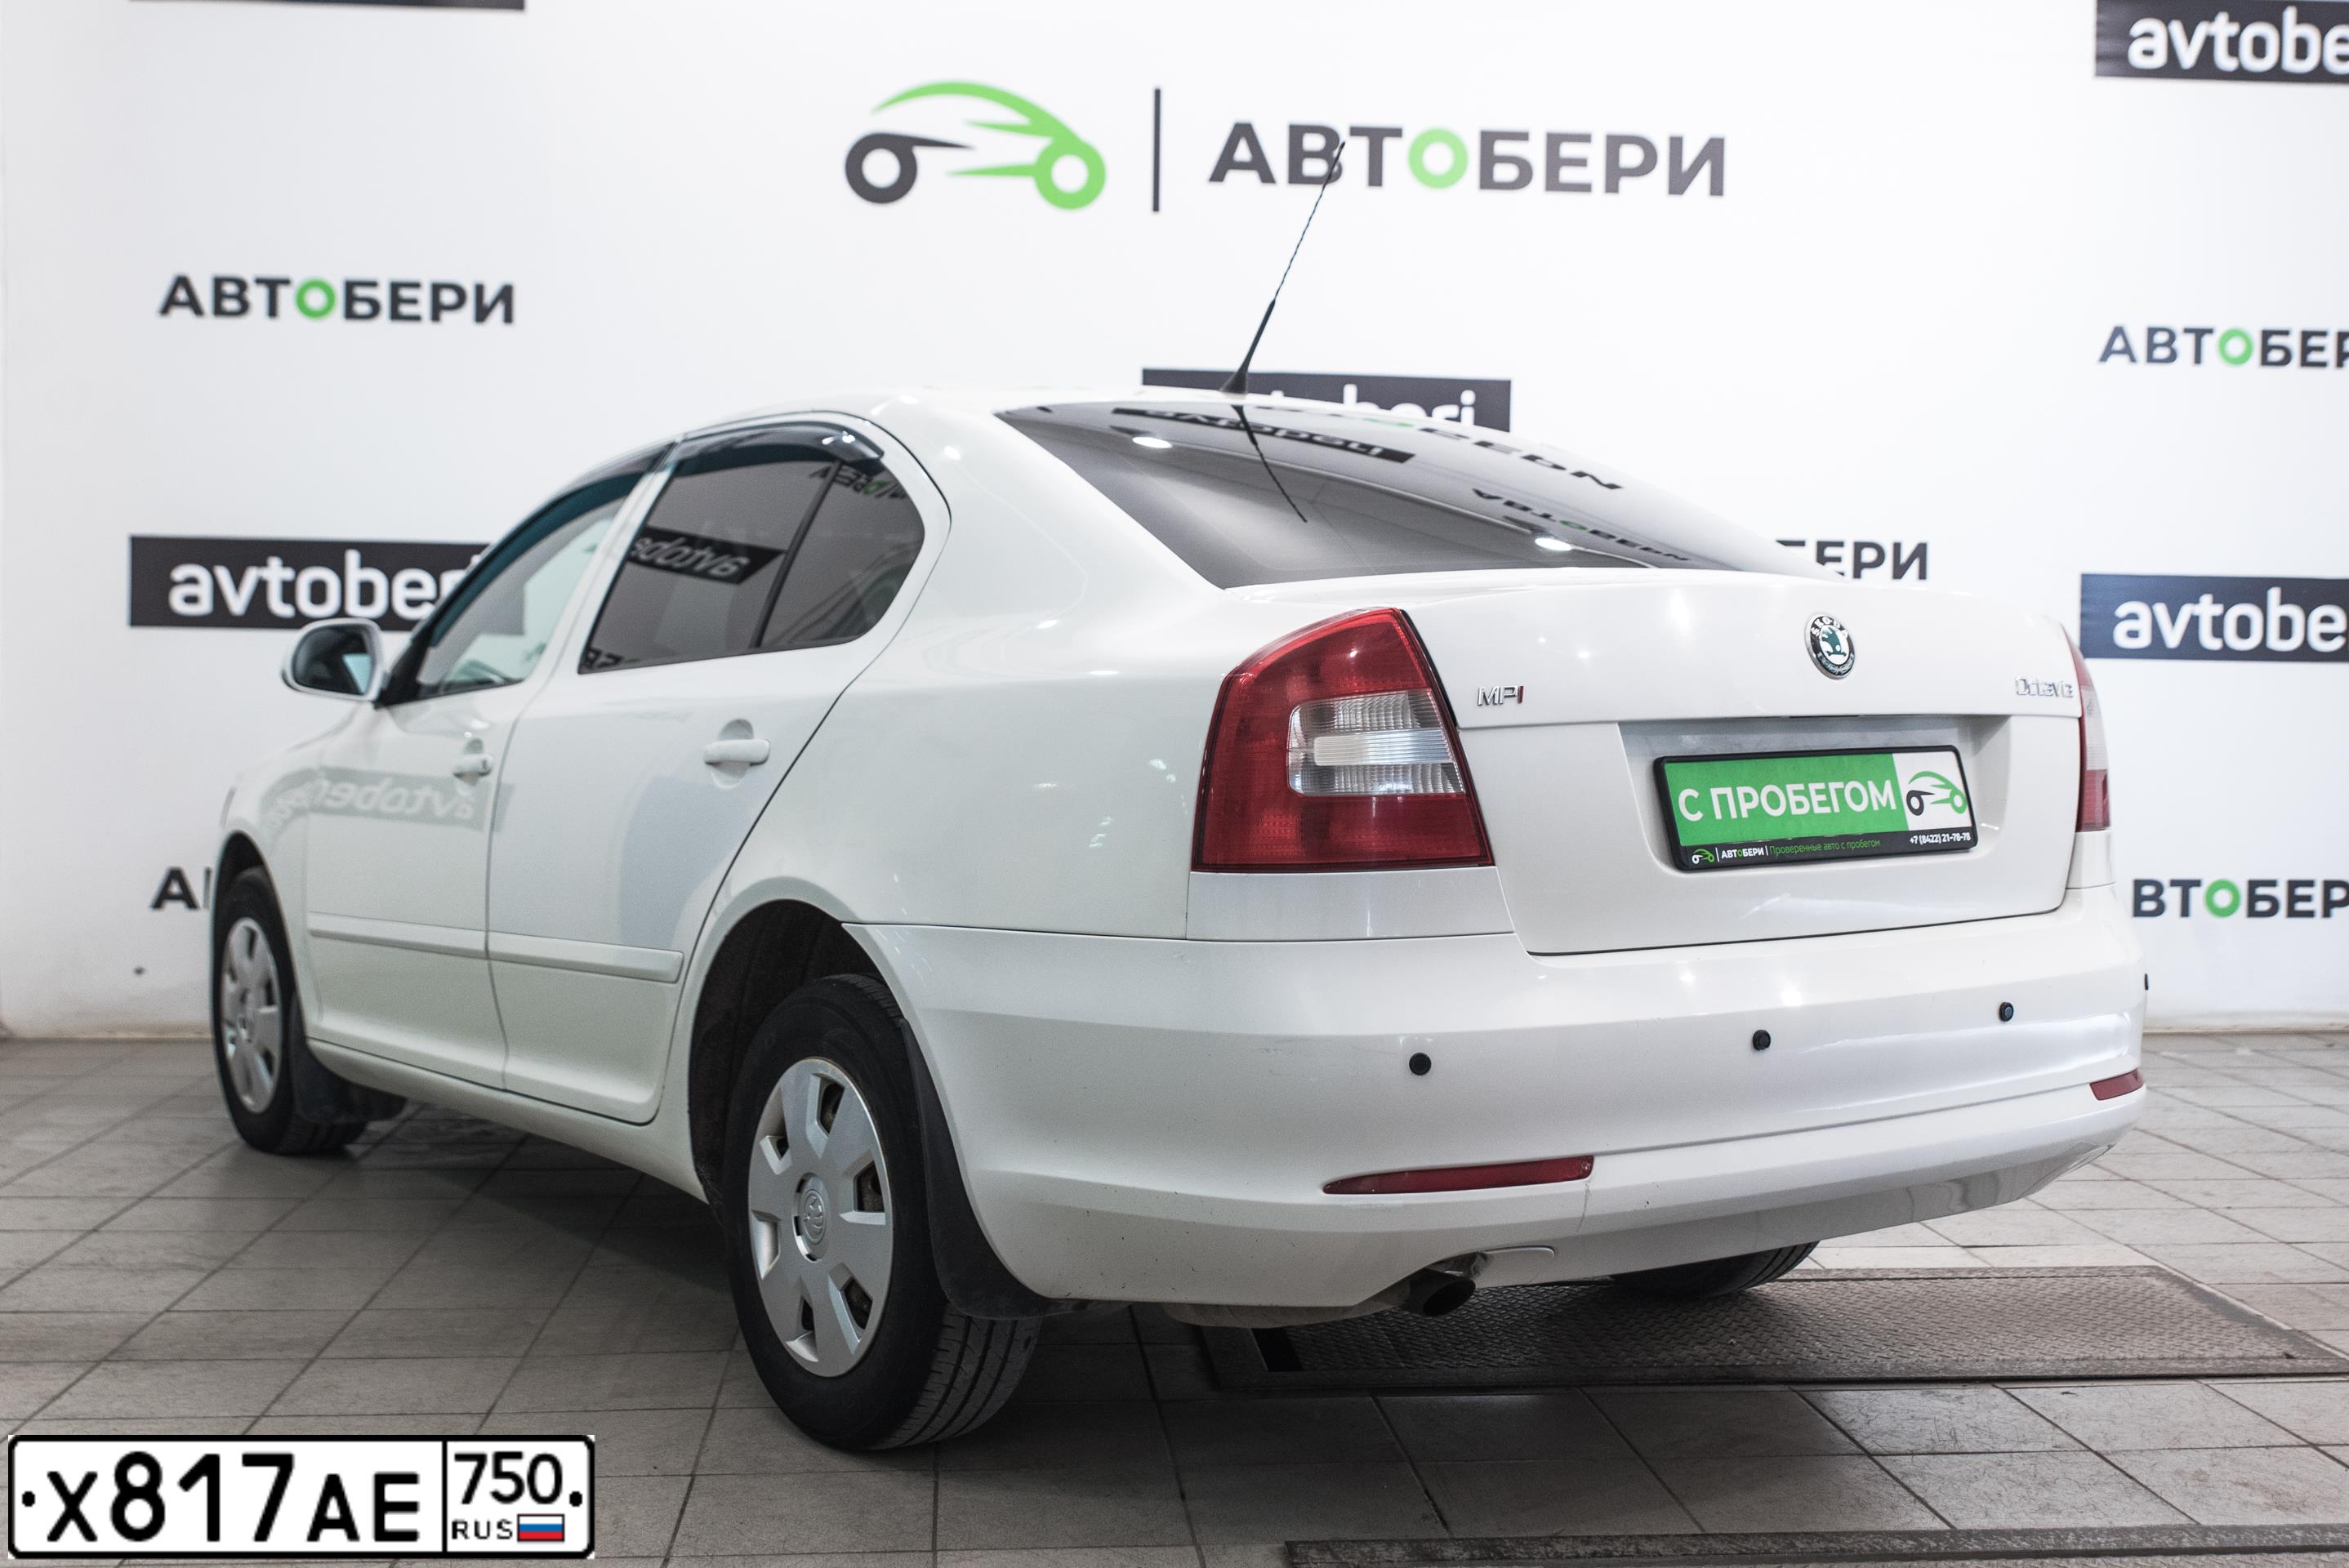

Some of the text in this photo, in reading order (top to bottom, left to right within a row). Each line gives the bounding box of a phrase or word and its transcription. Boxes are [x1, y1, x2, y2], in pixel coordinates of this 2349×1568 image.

[2128, 5, 2349, 75] avtobe
[1209, 122, 1725, 197] АВТОБЕРИ
[159, 274, 514, 324] АВТОБЕРИ
[168, 549, 481, 620] avtober
[1776, 540, 1928, 581] ЕРИ
[2113, 586, 2348, 653] avtobe
[1477, 685, 1524, 706] MPI
[1678, 780, 1897, 822] С ПРОБЕГОМ
[1721, 847, 1764, 859] АВТОБЕРИ
[1769, 844, 1822, 856] Проверенные
[1823, 842, 1840, 850] авто
[1847, 839, 1882, 851] пробегом
